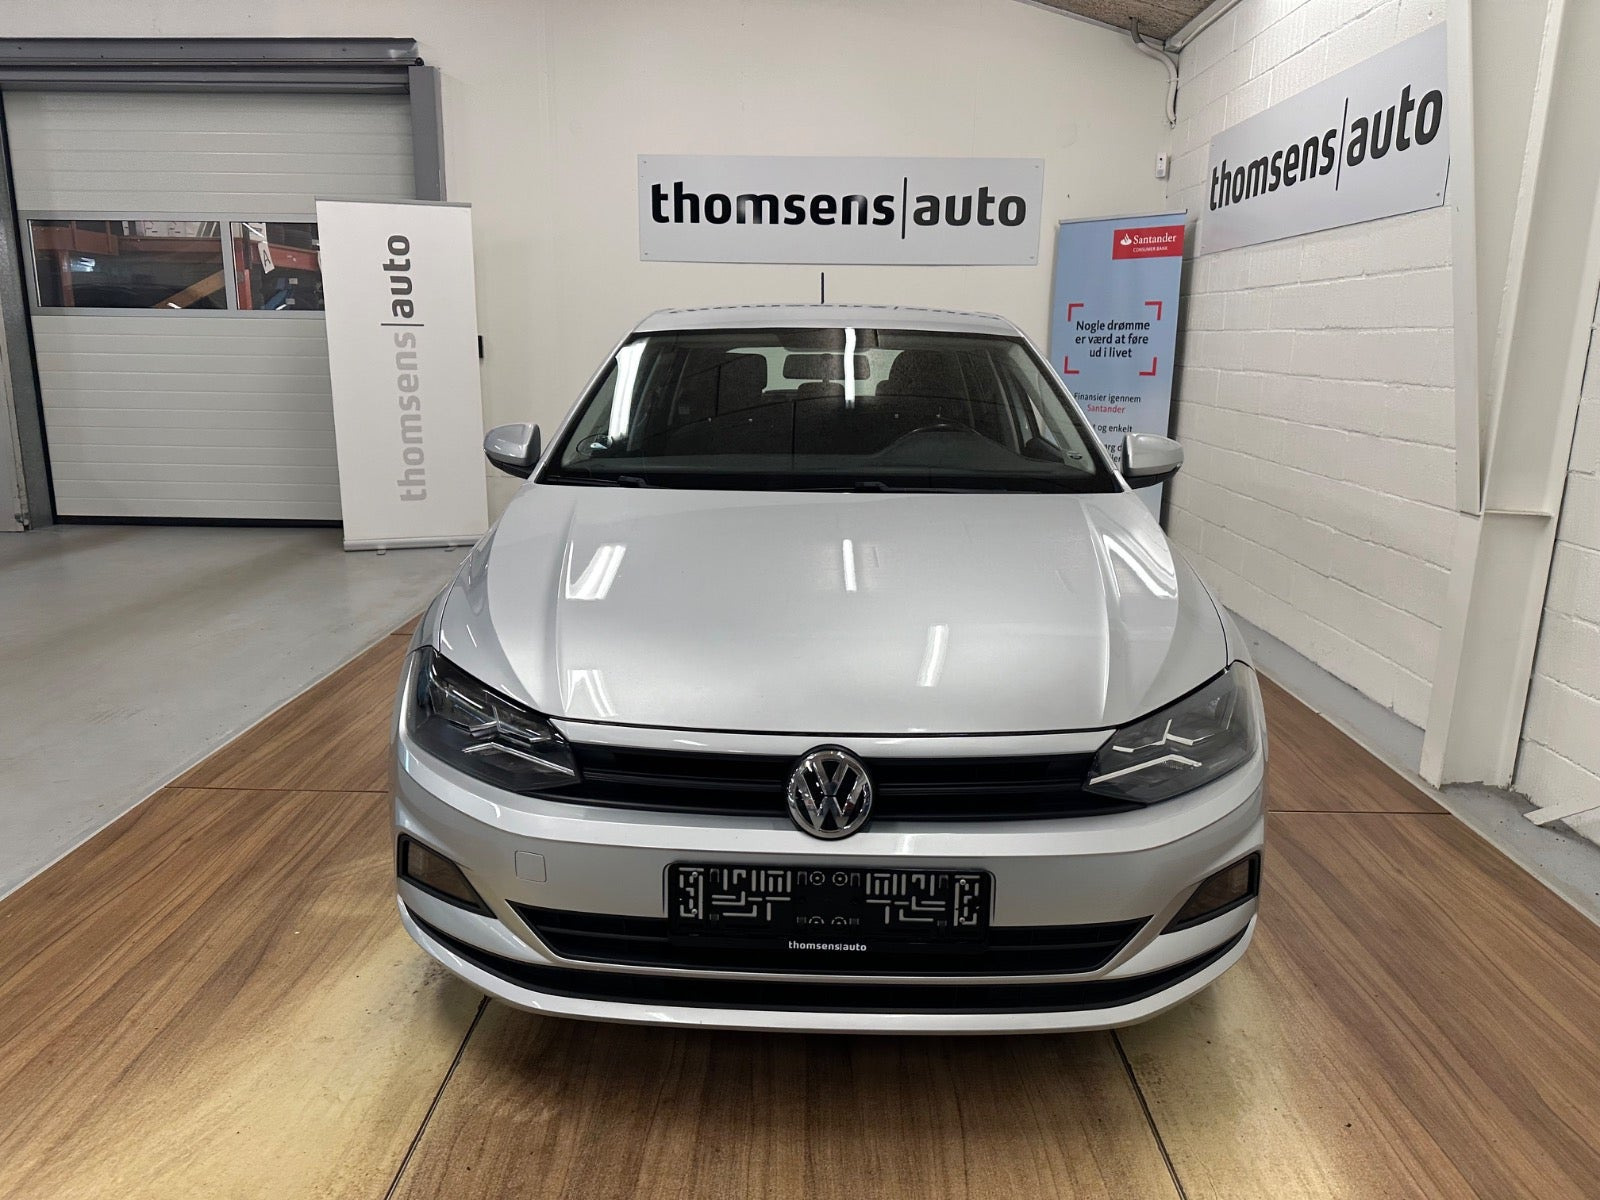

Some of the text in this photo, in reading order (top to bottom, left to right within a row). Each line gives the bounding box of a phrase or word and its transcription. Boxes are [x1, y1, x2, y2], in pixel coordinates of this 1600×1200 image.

[1209, 83, 1443, 211] thomsens auto
[651, 181, 1027, 227] thomsens auto
[1132, 232, 1177, 245] Santander
[1076, 319, 1150, 334] Nogle drømme
[1075, 333, 1149, 345] er værd at føre
[1089, 347, 1102, 358] ud
[1109, 347, 1132, 358] livet
[382, 234, 427, 502] thomsens auto
[1074, 392, 1141, 404] Finansier igennem
[1087, 404, 1125, 414] Santander
[1097, 424, 1107, 433] og
[1108, 424, 1133, 433] enkelt
